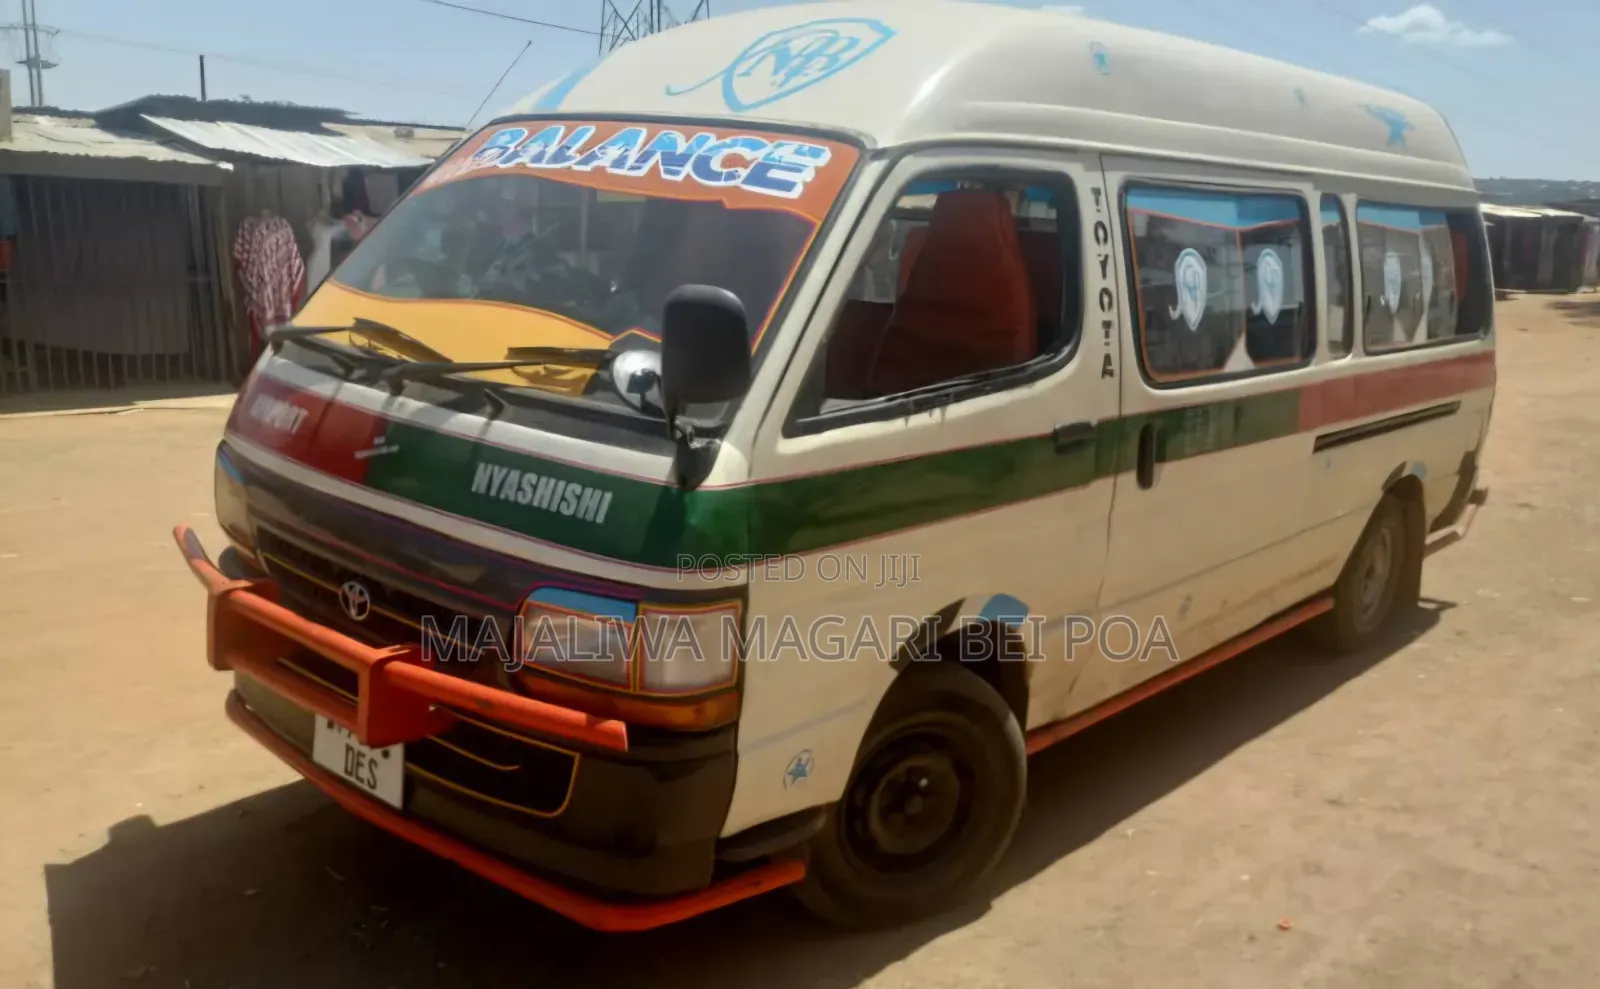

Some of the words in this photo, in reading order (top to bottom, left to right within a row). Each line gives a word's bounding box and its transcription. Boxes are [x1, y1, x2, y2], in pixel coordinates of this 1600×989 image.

[470, 125, 832, 199] BALANCE
[1091, 187, 1115, 379] TOYOTA
[471, 461, 613, 524] NYASHISHI
[344, 742, 378, 790] DES
